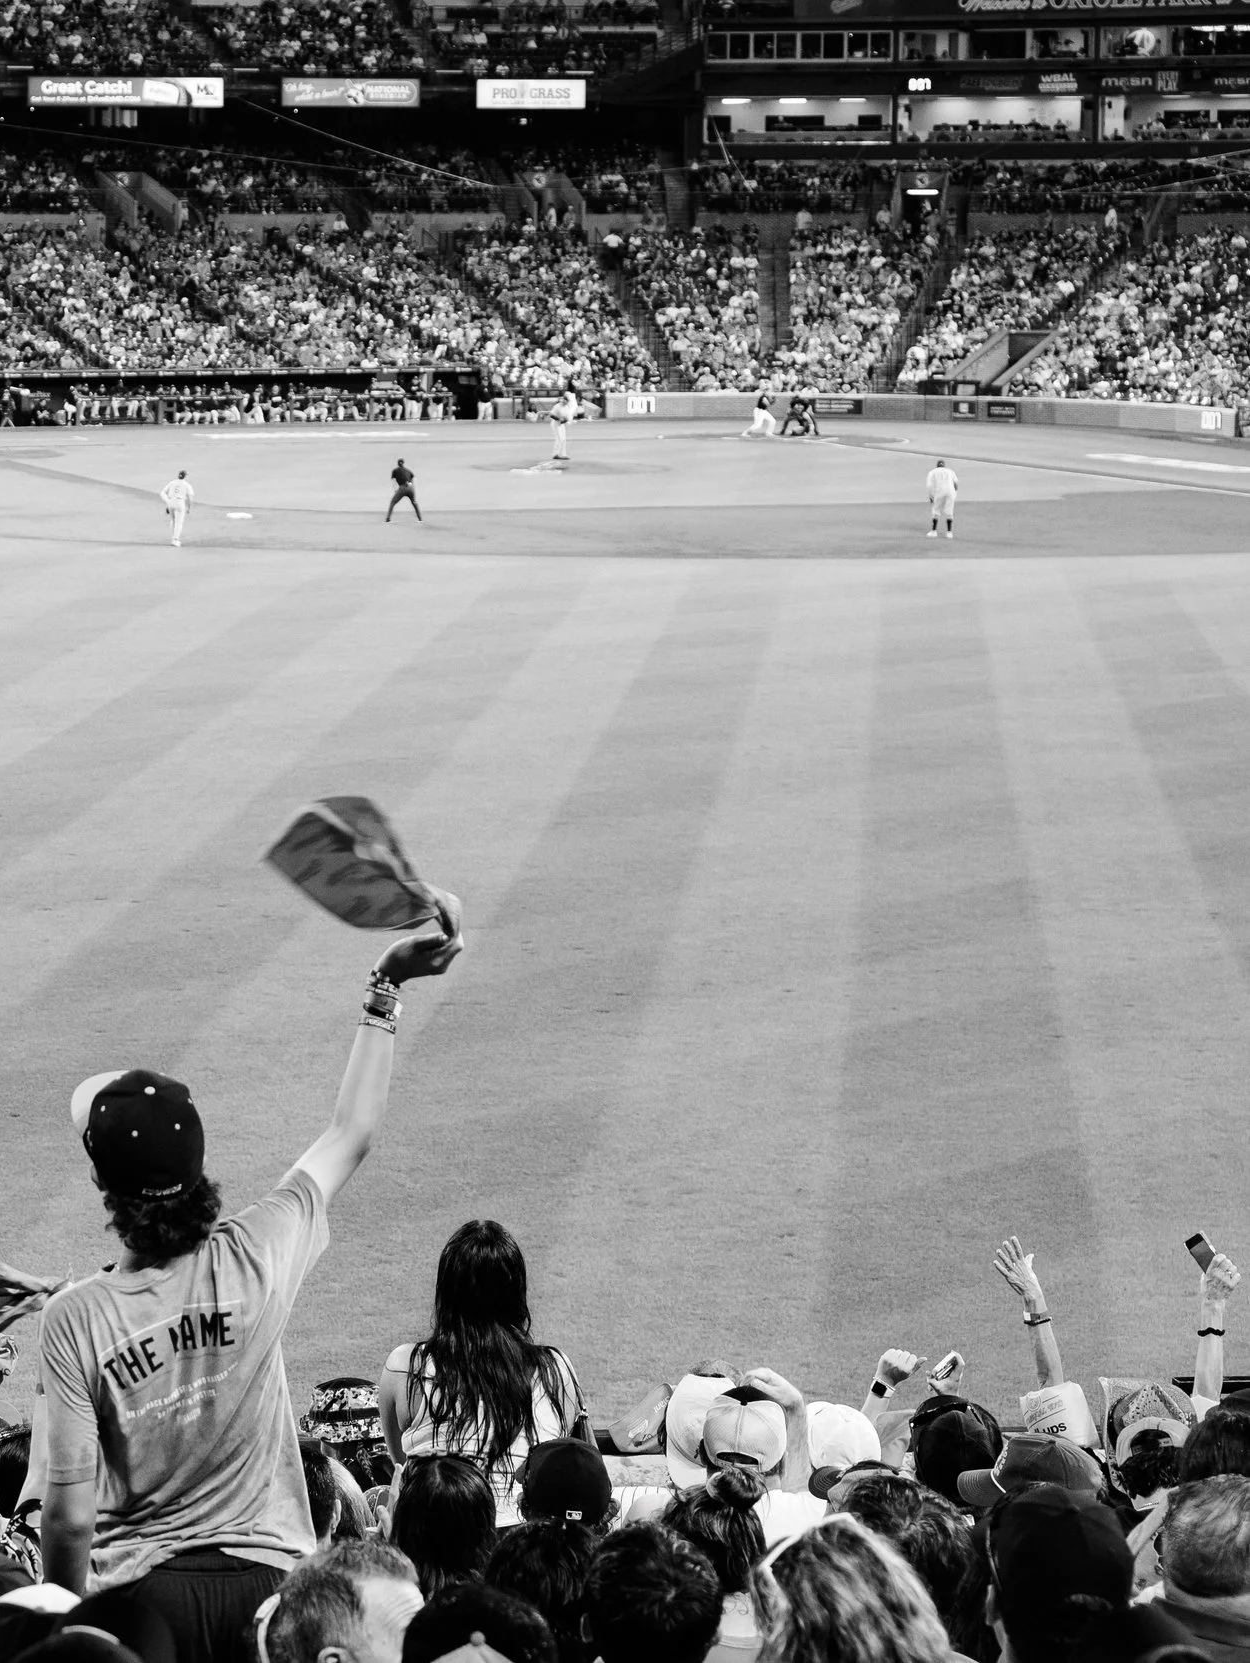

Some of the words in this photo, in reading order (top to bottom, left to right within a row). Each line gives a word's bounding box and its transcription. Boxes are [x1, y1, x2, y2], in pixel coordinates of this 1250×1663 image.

[1041, 73, 1076, 83] WBAL
[1101, 77, 1152, 88] masn
[40, 80, 83, 96] Great
[84, 80, 133, 96] Catch!
[366, 85, 411, 93] NATIONAL
[1157, 80, 1178, 91] PLAY
[492, 88, 517, 99] PRO
[530, 88, 571, 99] GRASS
[103, 1336, 164, 1390] THE
